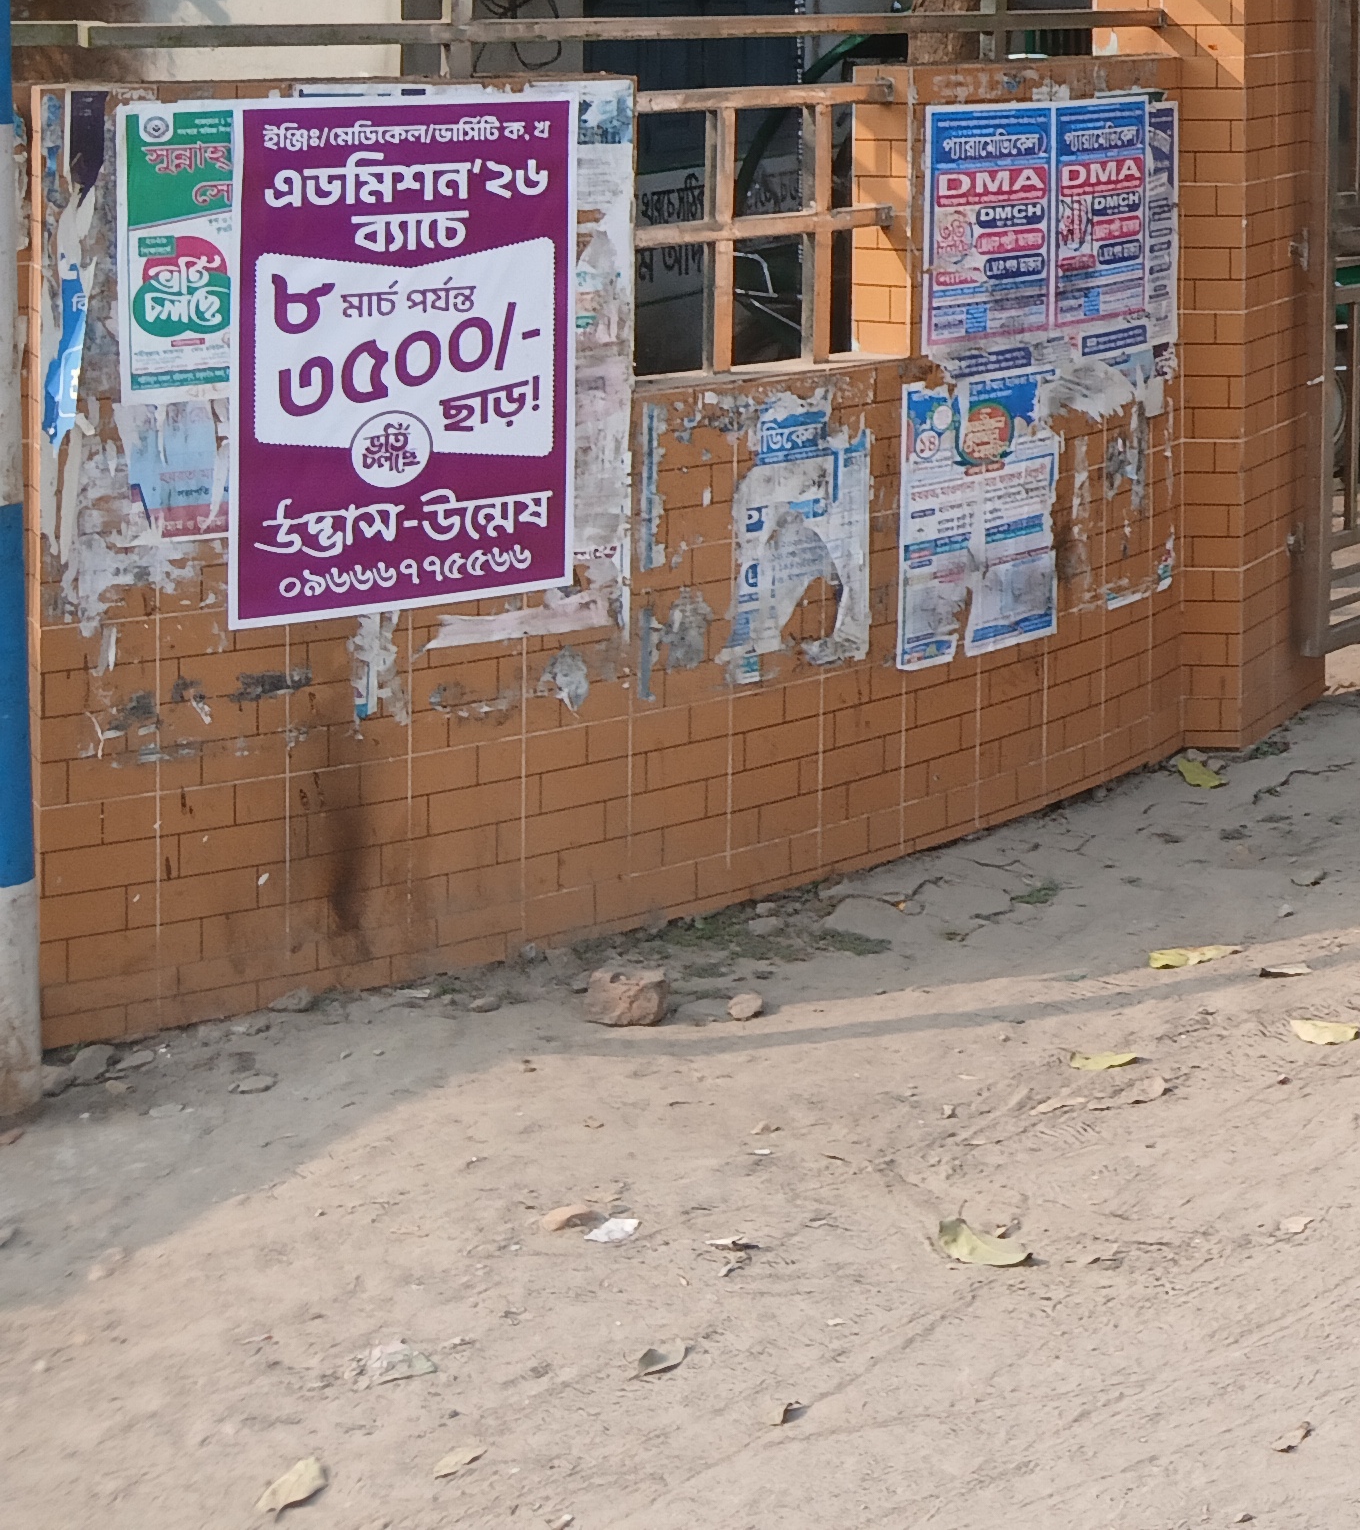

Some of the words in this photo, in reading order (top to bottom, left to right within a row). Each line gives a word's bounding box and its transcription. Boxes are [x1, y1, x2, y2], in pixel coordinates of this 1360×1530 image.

[534, 120, 550, 138] খ
[939, 169, 1045, 196] DMA
[1061, 159, 1141, 187] DMA
[980, 203, 1042, 221] DMCH
[1093, 192, 1140, 210] DMCH
[351, 210, 469, 252] ব্যাচে
[148, 255, 222, 295] ভর্তি
[145, 286, 230, 326] চলছে
[272, 274, 335, 334] ৮
[341, 280, 399, 318] মার্চ
[407, 276, 476, 313] পর্যন্ত
[278, 302, 540, 417] ৩৫০০/-
[439, 375, 540, 432] ছাড়!
[254, 488, 553, 558] উদ্ভাস-উন্মেষ
[279, 545, 532, 598] ০৯৬৬৬৭৭৫৫৬৬
